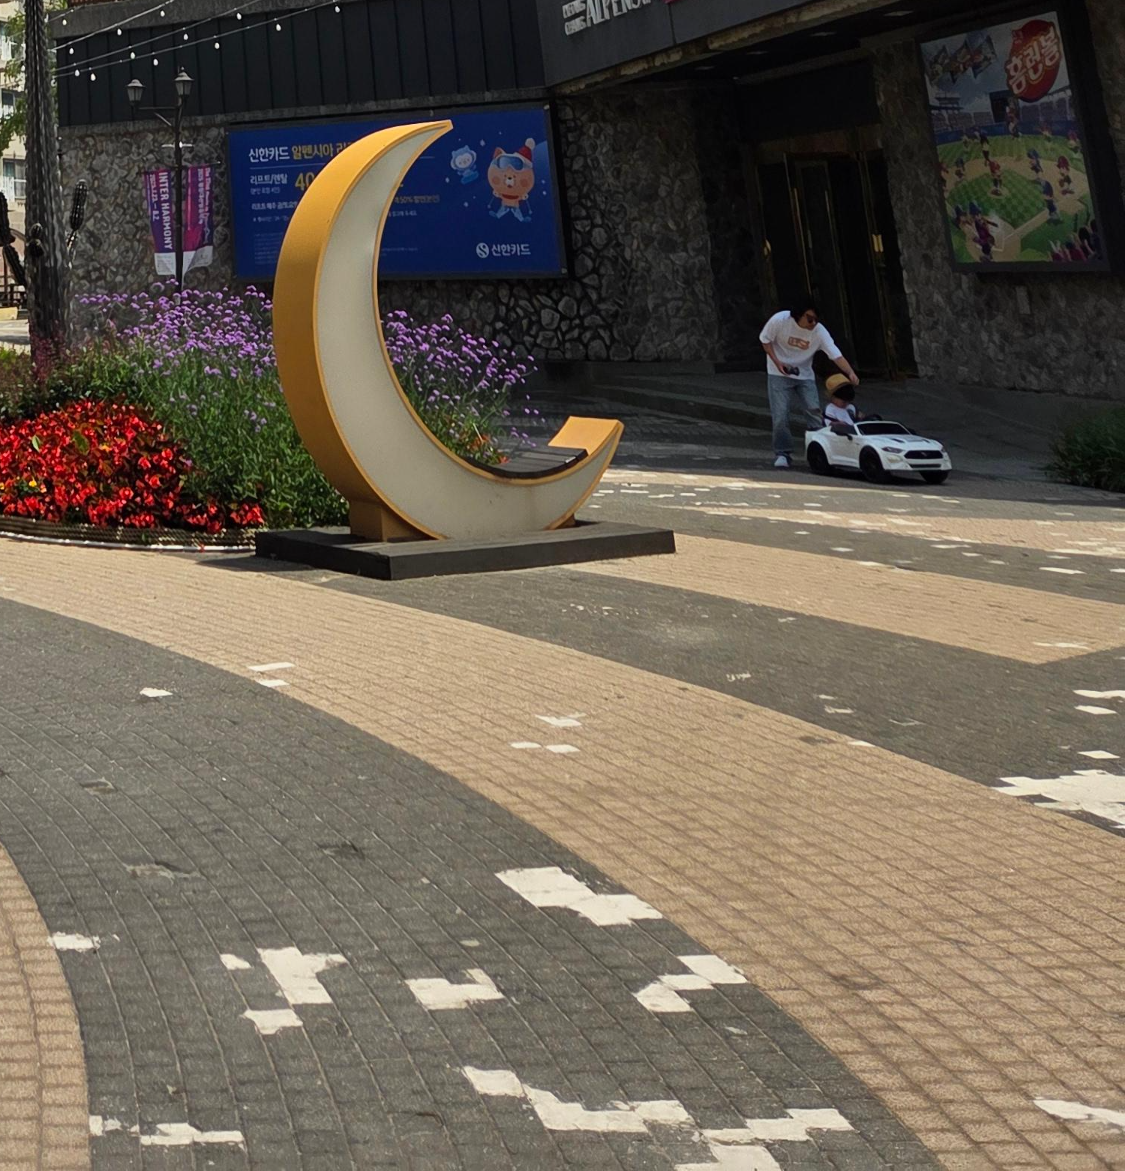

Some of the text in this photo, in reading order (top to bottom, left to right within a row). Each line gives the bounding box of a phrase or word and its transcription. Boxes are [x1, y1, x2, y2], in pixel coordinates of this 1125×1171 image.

[1006, 25, 1060, 95] 홈런볼
[249, 146, 290, 163] 신한카드
[292, 143, 333, 160] 알펜시아
[158, 172, 173, 250] INTER HARMONY
[491, 243, 531, 256] 신한카드
